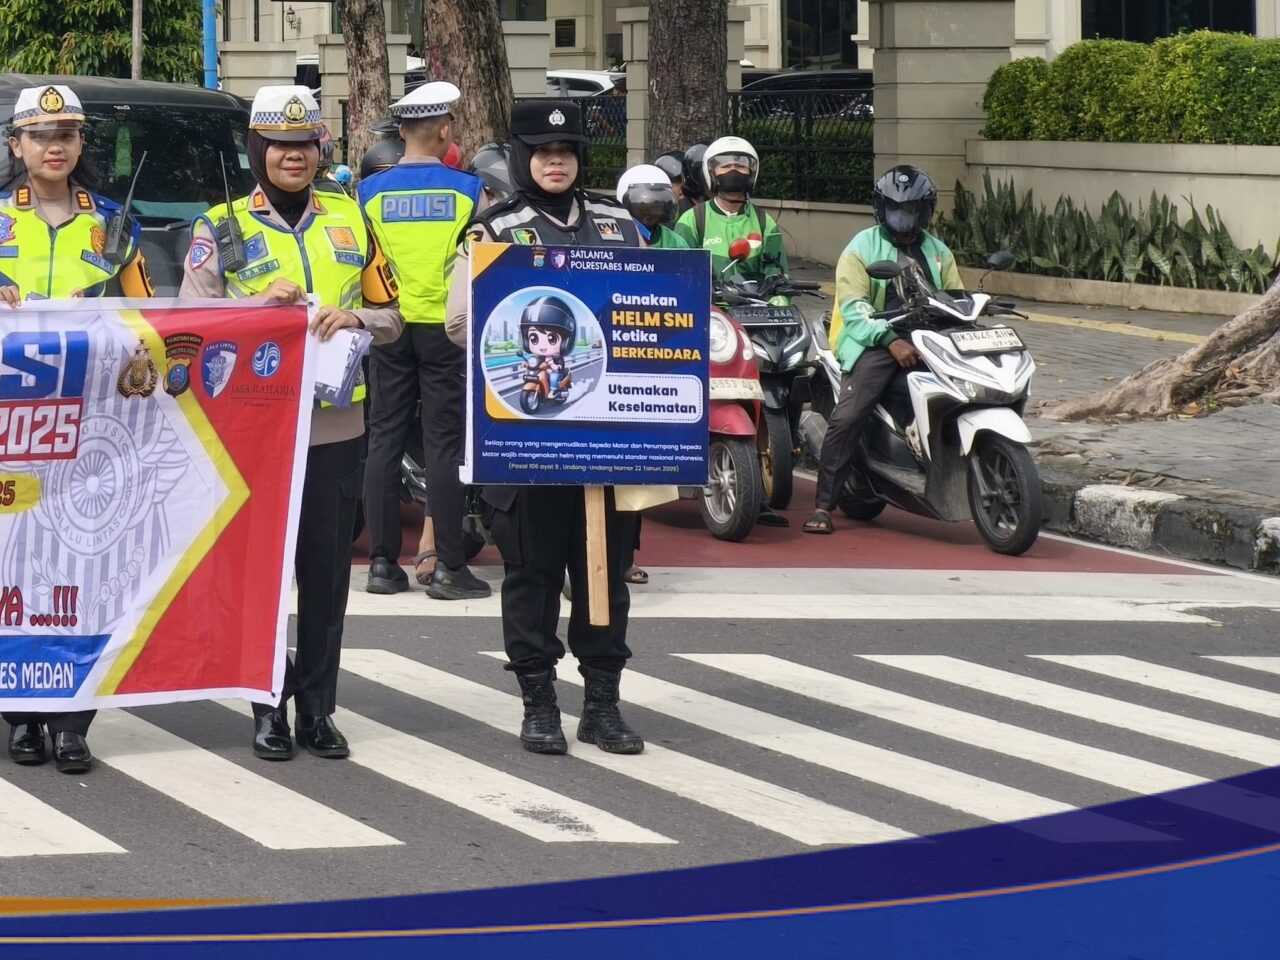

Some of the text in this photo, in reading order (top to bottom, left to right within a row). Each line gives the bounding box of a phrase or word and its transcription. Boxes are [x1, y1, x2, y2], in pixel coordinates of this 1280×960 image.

[383, 196, 455, 219] POLISI
[570, 250, 613, 259] SATLANTAS
[570, 260, 654, 272] POLRESTABES MEDAN
[611, 293, 677, 306] Gunakan
[611, 311, 693, 328] HELM SNI
[611, 329, 658, 342] Ketika
[612, 347, 701, 360] BERKENDARA
[608, 384, 678, 396] Utamakan
[608, 401, 697, 414] Keselamatan
[524, 441, 540, 449] yang
[85, 520, 121, 548] LINTAS
[22, 661, 74, 690] MEDAN
